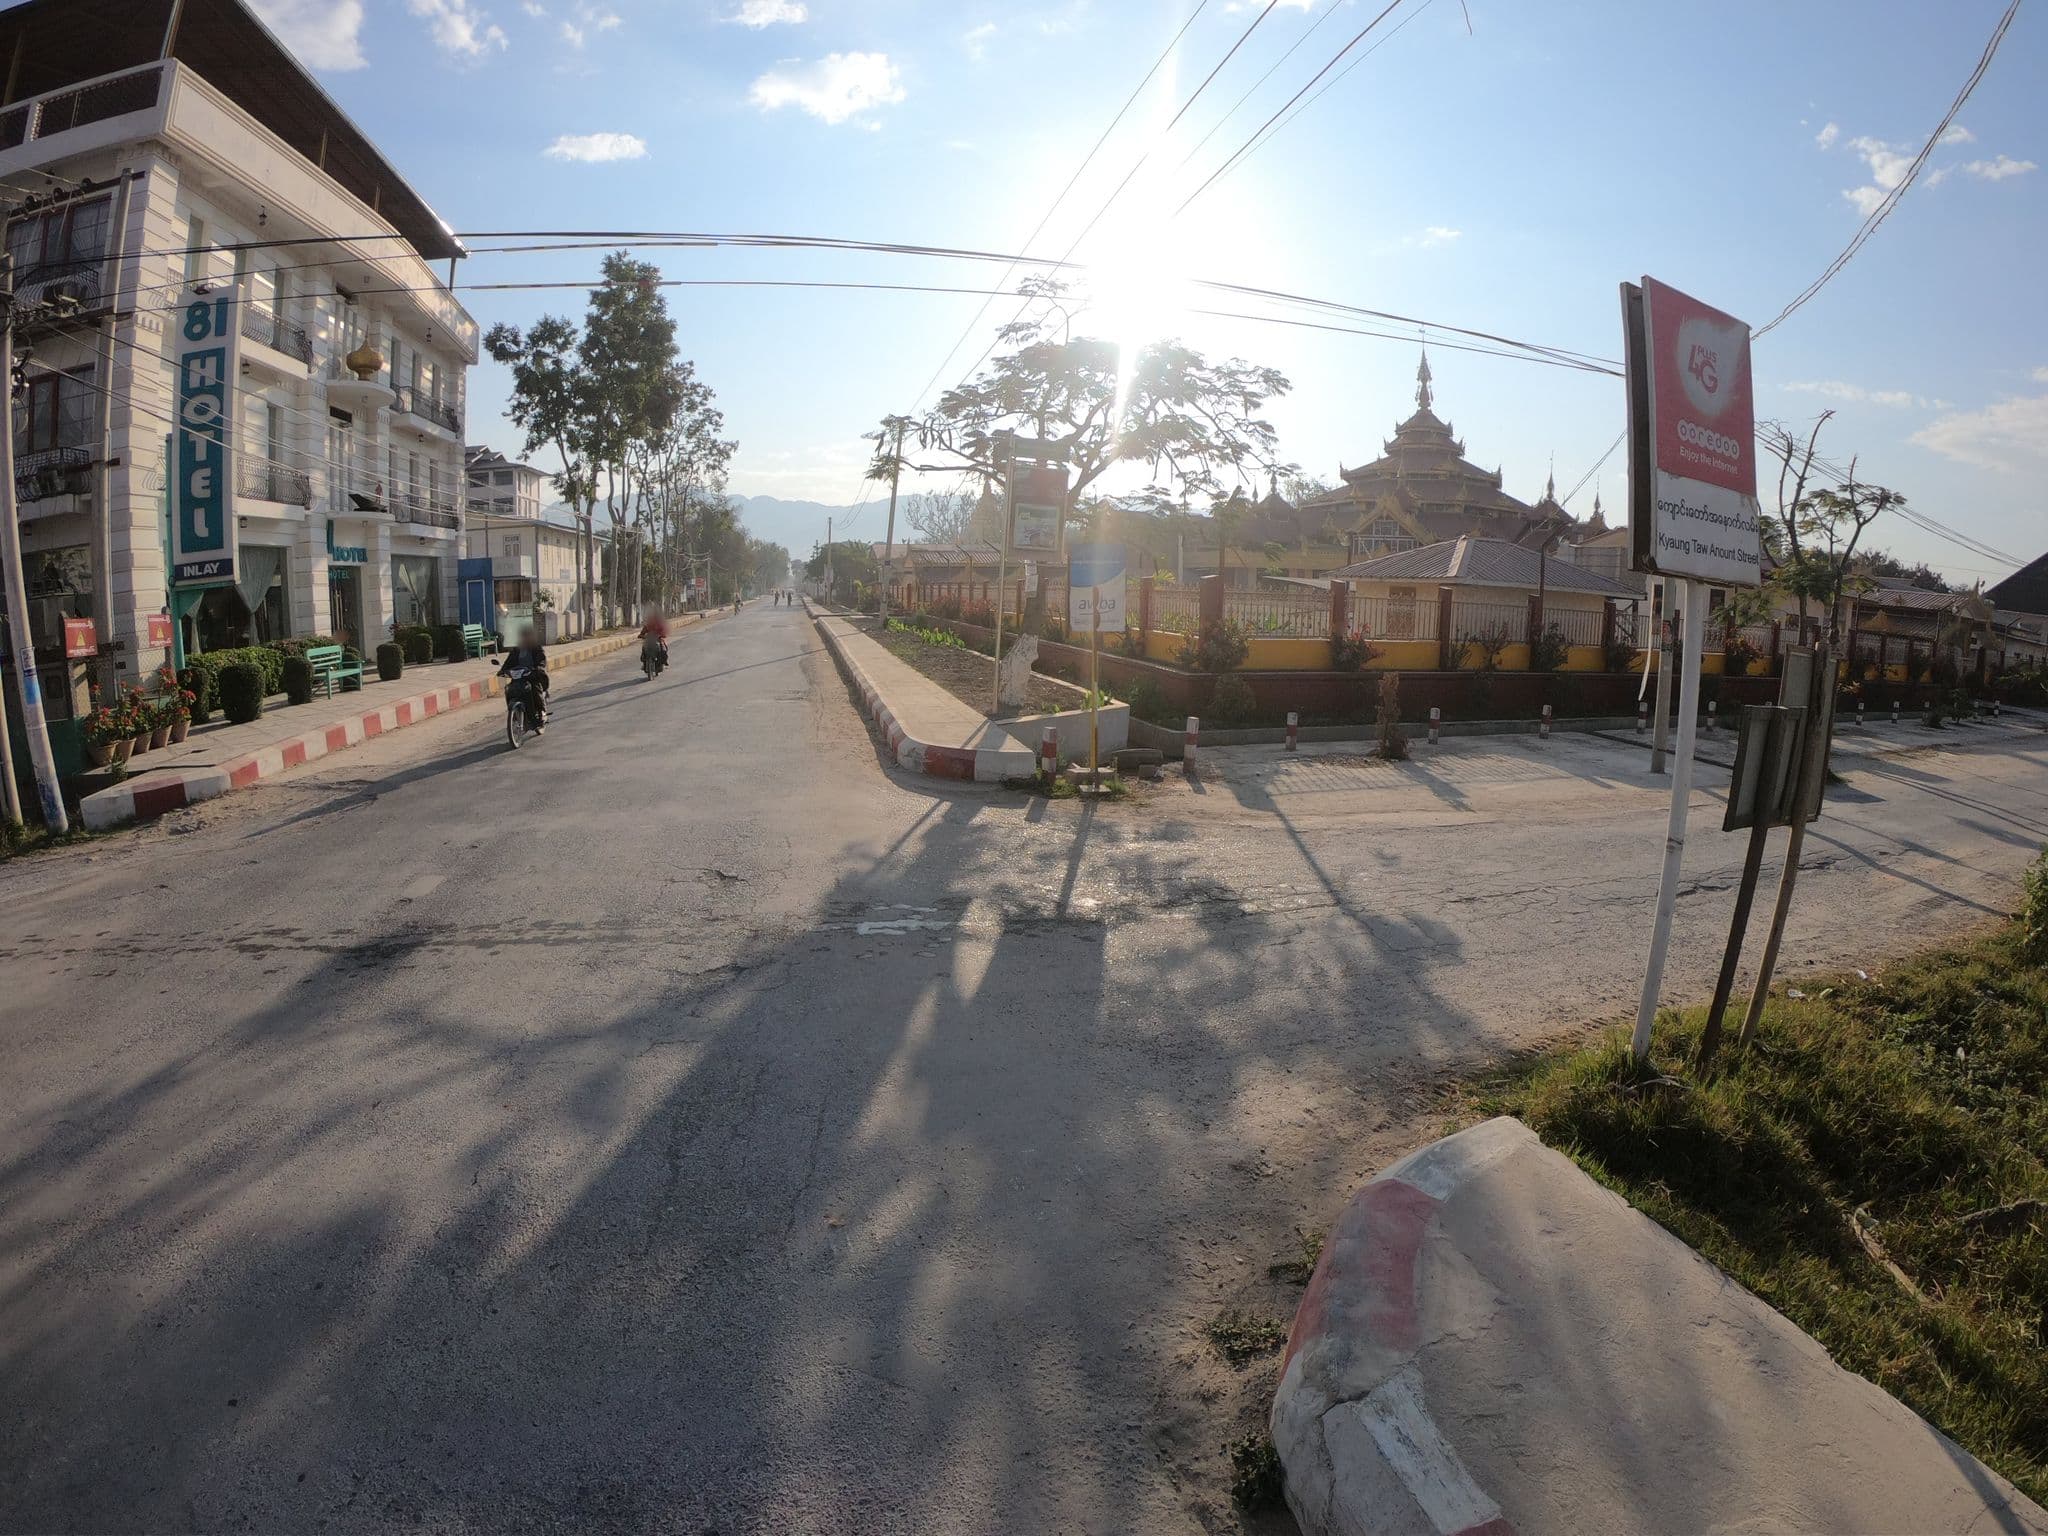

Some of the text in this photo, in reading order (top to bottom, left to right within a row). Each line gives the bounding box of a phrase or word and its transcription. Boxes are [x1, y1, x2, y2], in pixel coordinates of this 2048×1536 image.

[184, 297, 229, 341] 81
[1688, 345, 1718, 393] 4G
[1697, 345, 1718, 361] PLUS
[183, 355, 222, 538] HOTEL
[1679, 423, 1738, 457] ooredoo
[1680, 446, 1699, 463] Enjoy
[1700, 453, 1712, 465] the
[333, 546, 368, 563] HOTEL
[1659, 532, 1759, 565] Kyaung Taw Anount Street
[183, 562, 220, 577] INLAY
